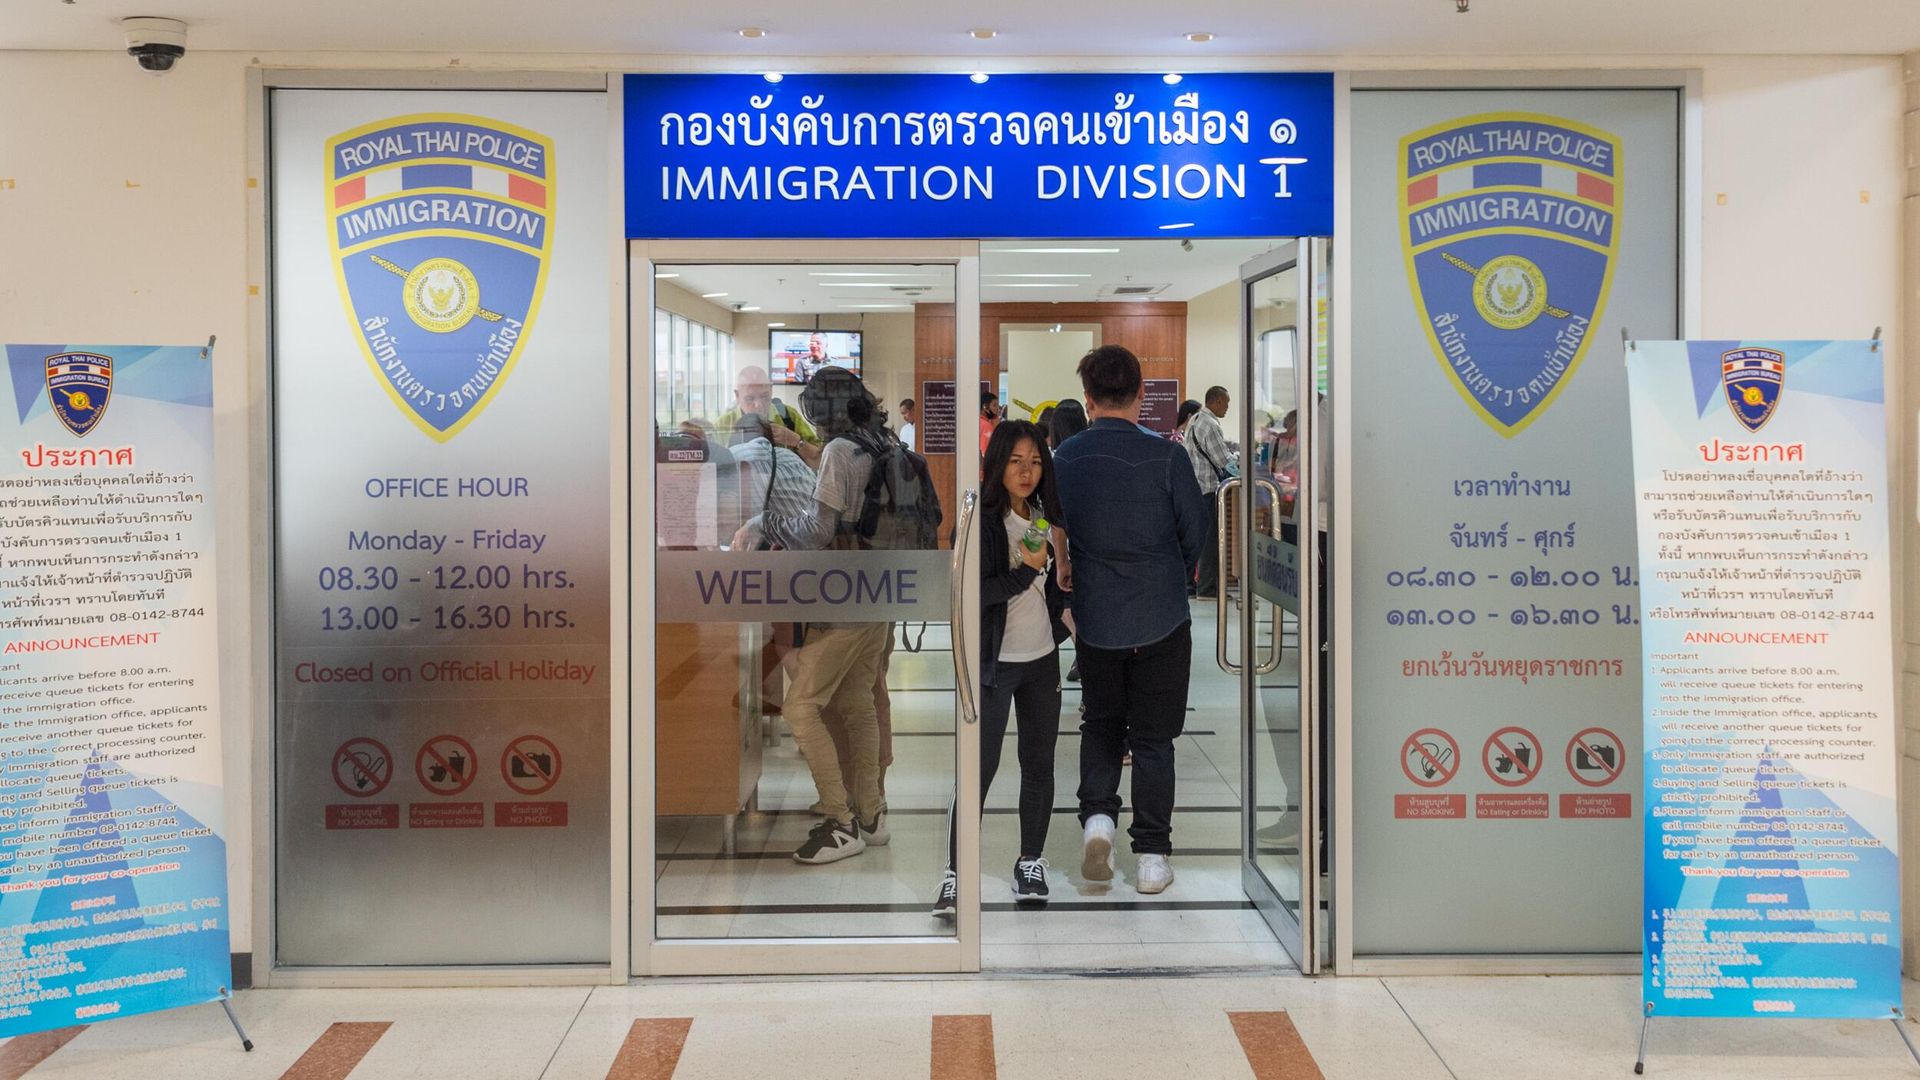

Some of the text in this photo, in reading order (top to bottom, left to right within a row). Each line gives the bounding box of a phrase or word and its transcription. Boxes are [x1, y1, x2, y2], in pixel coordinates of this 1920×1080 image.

[659, 92, 1297, 147] กองบังคับการตรวจคนเข้าเมือง ๑
[340, 130, 542, 170] ROYAL THAI POLICE
[1413, 129, 1611, 169] ROYAL THAI POLICE
[661, 163, 1292, 201] IMMIGRATION DIVISION 1
[342, 198, 540, 240] IMMIGRATION
[1415, 197, 1606, 238] IMMIGRATION
[49, 357, 70, 366] ROYAL
[87, 357, 108, 366] POLICE
[363, 316, 523, 411] สำนักงานตรวจคนเข้าเมือง
[22, 444, 132, 467] ประกาศ
[1699, 439, 1802, 461] ประกาศ
[365, 477, 529, 498] OFFICE HOUR
[1454, 472, 1571, 497] เวลาทำงาน
[176, 532, 182, 540] 1
[348, 530, 447, 554] Monday
[473, 529, 547, 553] Friday
[1450, 522, 1508, 548] จันทร์
[1534, 522, 1576, 556] ศุกร์
[1658, 528, 1850, 540] กองบังคับการตรวจคนเข้าเมือง 1
[319, 566, 398, 590] 08.30
[434, 565, 511, 589] 12.00
[522, 564, 575, 589] hrs.
[696, 569, 917, 604] WELCOME
[1386, 566, 1476, 587] ๐๘.๓๐
[1510, 565, 1600, 587] ๑๒.๐๐
[1611, 565, 1639, 588] น.
[76, 588, 164, 604] ทราบโดยทันที
[1749, 588, 1833, 600] ทราบโดยทันที
[109, 607, 204, 622] 08-0142-8744
[321, 605, 398, 630] 13.00
[434, 605, 511, 629] 16.30
[522, 603, 575, 629] hrs.
[1386, 606, 1476, 626] ๑๓.๐๐
[1510, 604, 1600, 626] ๑๖.๓๐
[1611, 603, 1639, 626] น.
[1780, 610, 1874, 620] 08-0142-8744
[4, 632, 160, 653] ANNOUNCEMENT
[1684, 632, 1830, 643] ANNOUNCEMENT
[41, 674, 74, 682] arrive
[78, 670, 116, 680] before
[120, 668, 143, 676] 8.00
[294, 659, 595, 684] Closed on Official Holiday
[1402, 651, 1623, 684] ยกเว้นวันหยุดราชการ
[1660, 666, 1714, 675] Applicants
[1718, 666, 1747, 674] arrive
[1751, 667, 1787, 675] before
[1790, 667, 1813, 675] 8.00
[46, 687, 83, 697] queue
[88, 683, 124, 693] tickets
[128, 681, 144, 689] for
[148, 678, 194, 688] entering
[1660, 680, 1863, 691] will receive queue tickets for entering
[3, 706, 22, 714] the
[100, 697, 135, 706] office.
[111, 709, 146, 719] office,
[150, 705, 207, 716] applicants
[47, 719, 193, 739] another queue tickets for
[52, 743, 92, 753] correct
[97, 737, 155, 750] processing
[160, 733, 206, 742] counter.
[83, 754, 108, 763] staff
[113, 753, 130, 761] are
[135, 746, 195, 758] authorized
[1420, 808, 1455, 816] SMOKING
[1490, 808, 1510, 816] Eating
[1521, 808, 1548, 816] Drinking
[39, 879, 59, 888] you
[111, 863, 179, 877] co-operation
